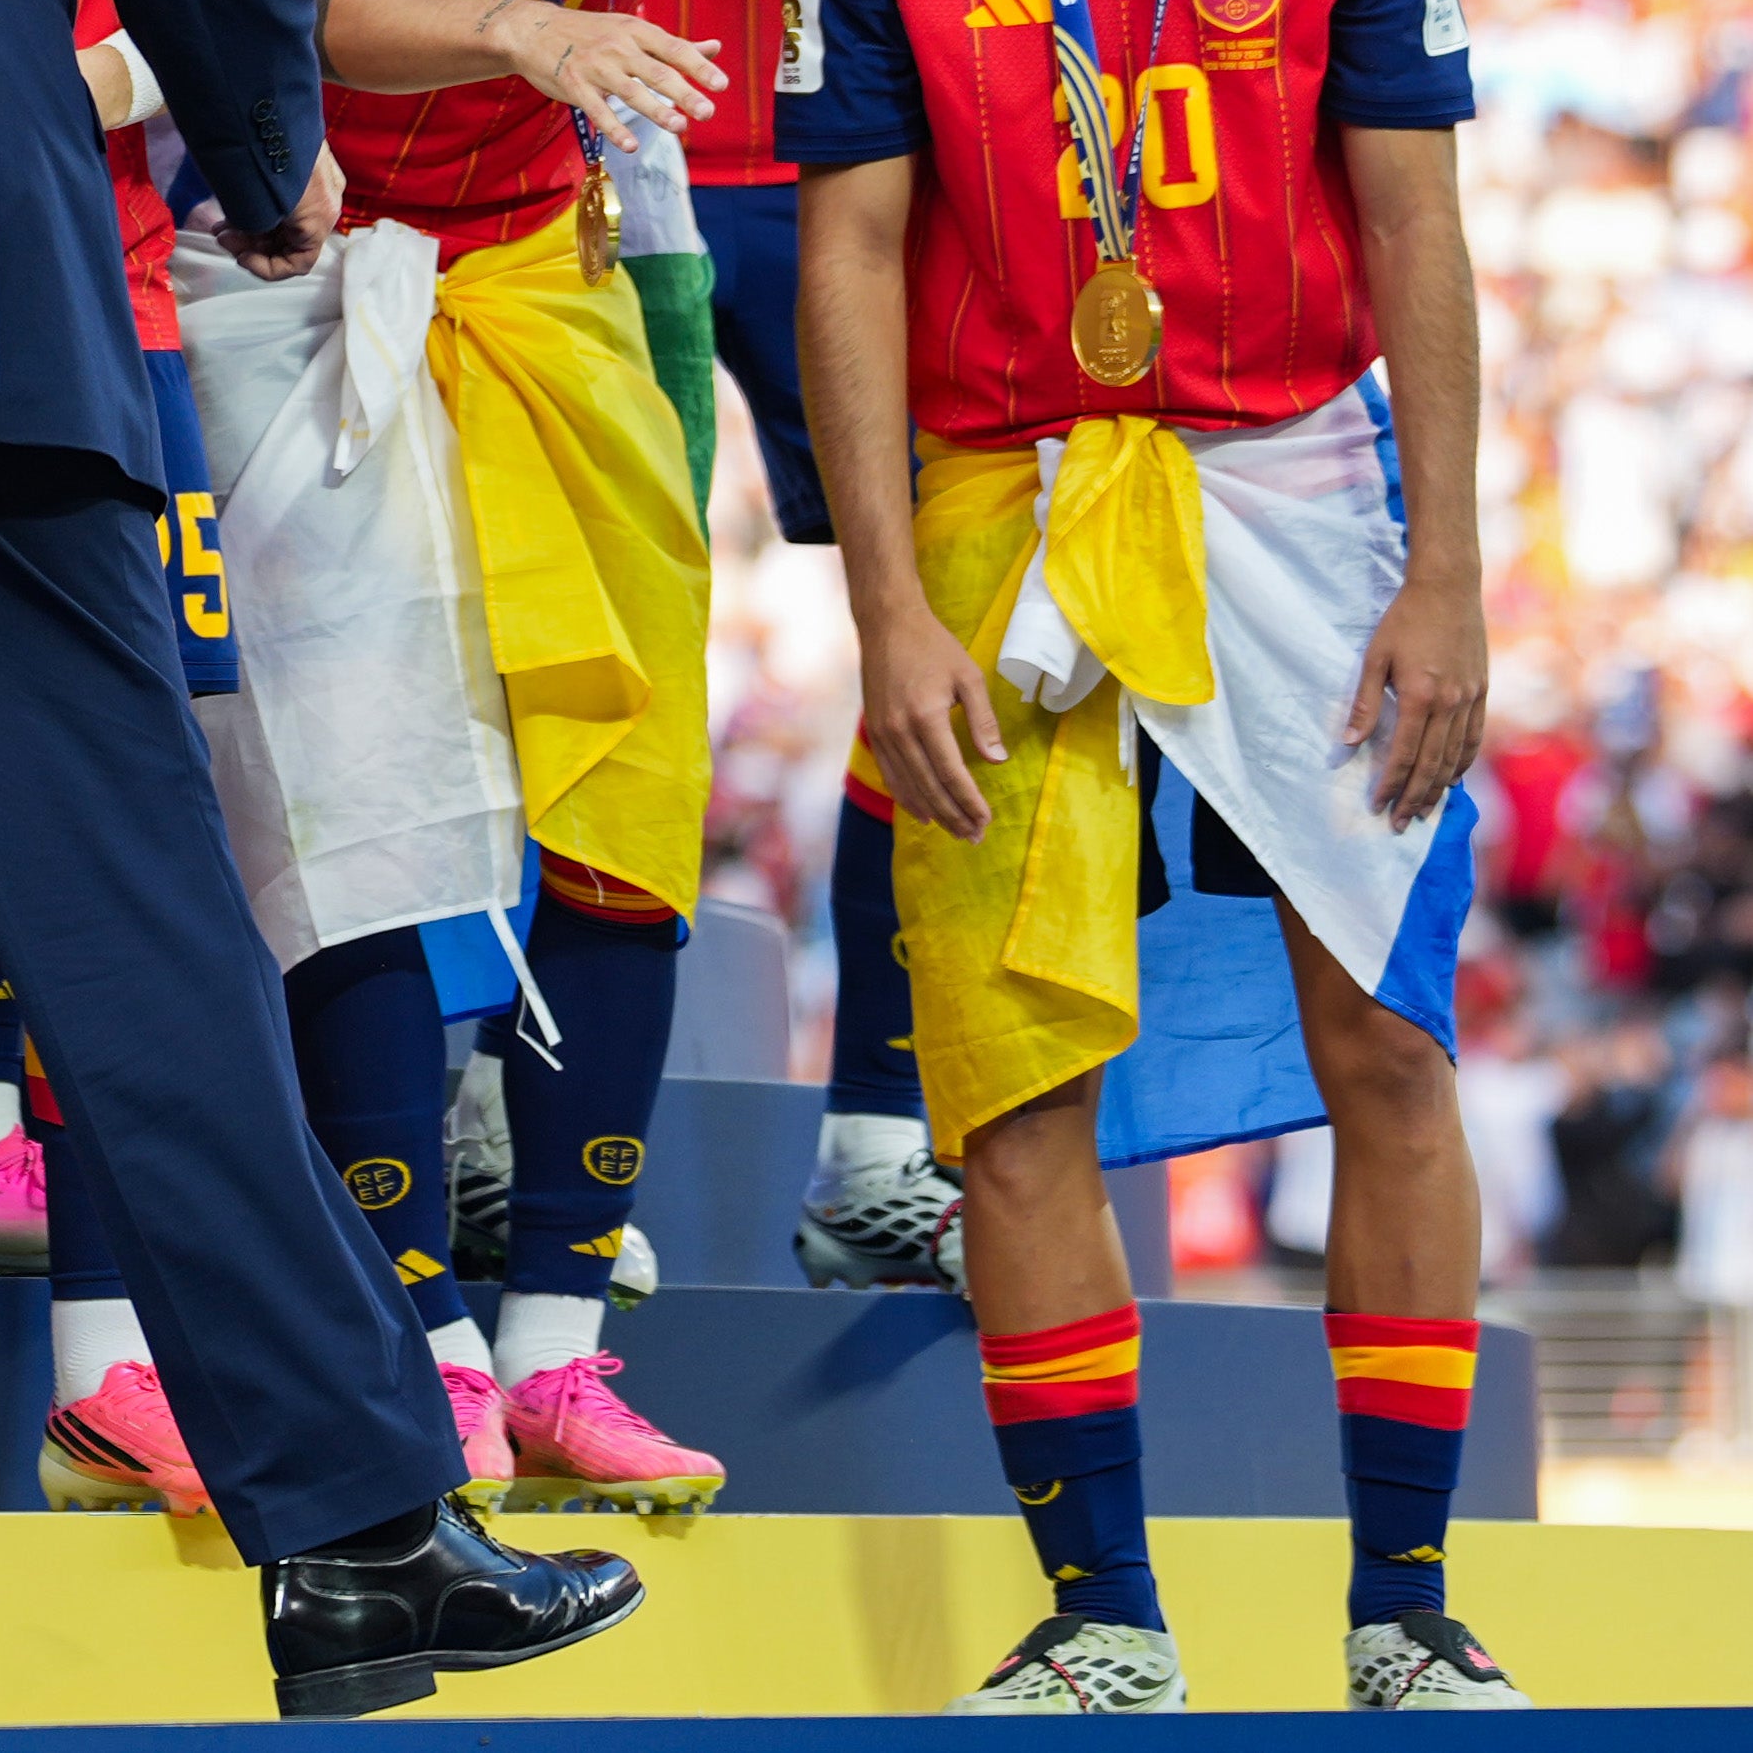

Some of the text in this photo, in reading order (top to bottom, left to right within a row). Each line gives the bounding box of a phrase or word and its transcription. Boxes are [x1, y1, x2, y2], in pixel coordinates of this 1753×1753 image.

[1053, 64, 1219, 221] 20
[599, 1145, 636, 1159] RF
[353, 1168, 392, 1187] RF
[599, 1161, 633, 1175] EF
[357, 1182, 394, 1202] EF
